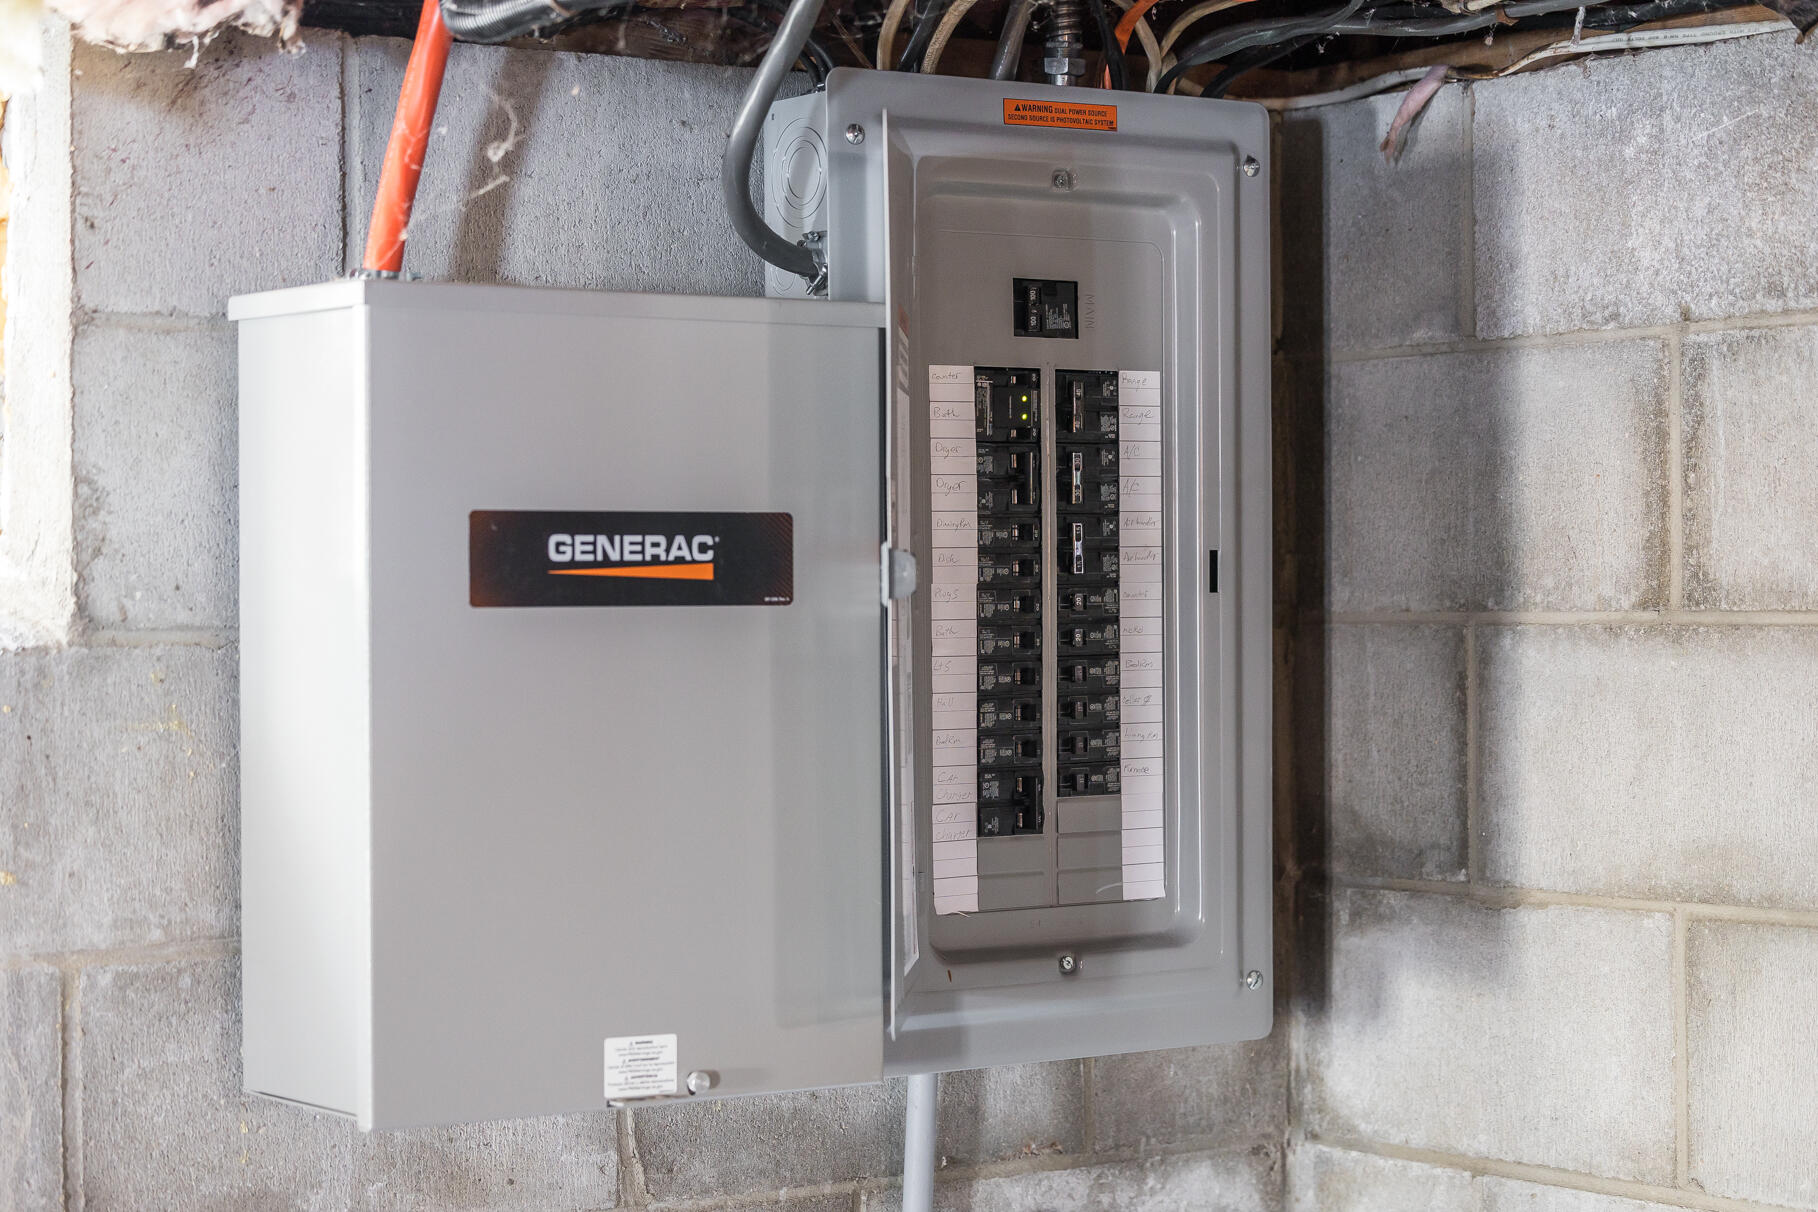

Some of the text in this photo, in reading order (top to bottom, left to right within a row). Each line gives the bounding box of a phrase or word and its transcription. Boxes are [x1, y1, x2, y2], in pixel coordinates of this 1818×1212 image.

[1021, 104, 1053, 114] WARNING
[1007, 113, 1028, 121] SECOND
[1028, 114, 1049, 122] SOURCE
[1056, 117, 1094, 126] PHOTOVOLTAIC
[936, 477, 967, 497] Dryer
[548, 533, 714, 562] GENERAC
[1076, 597, 1082, 605] 20
[1075, 633, 1081, 642] 20
